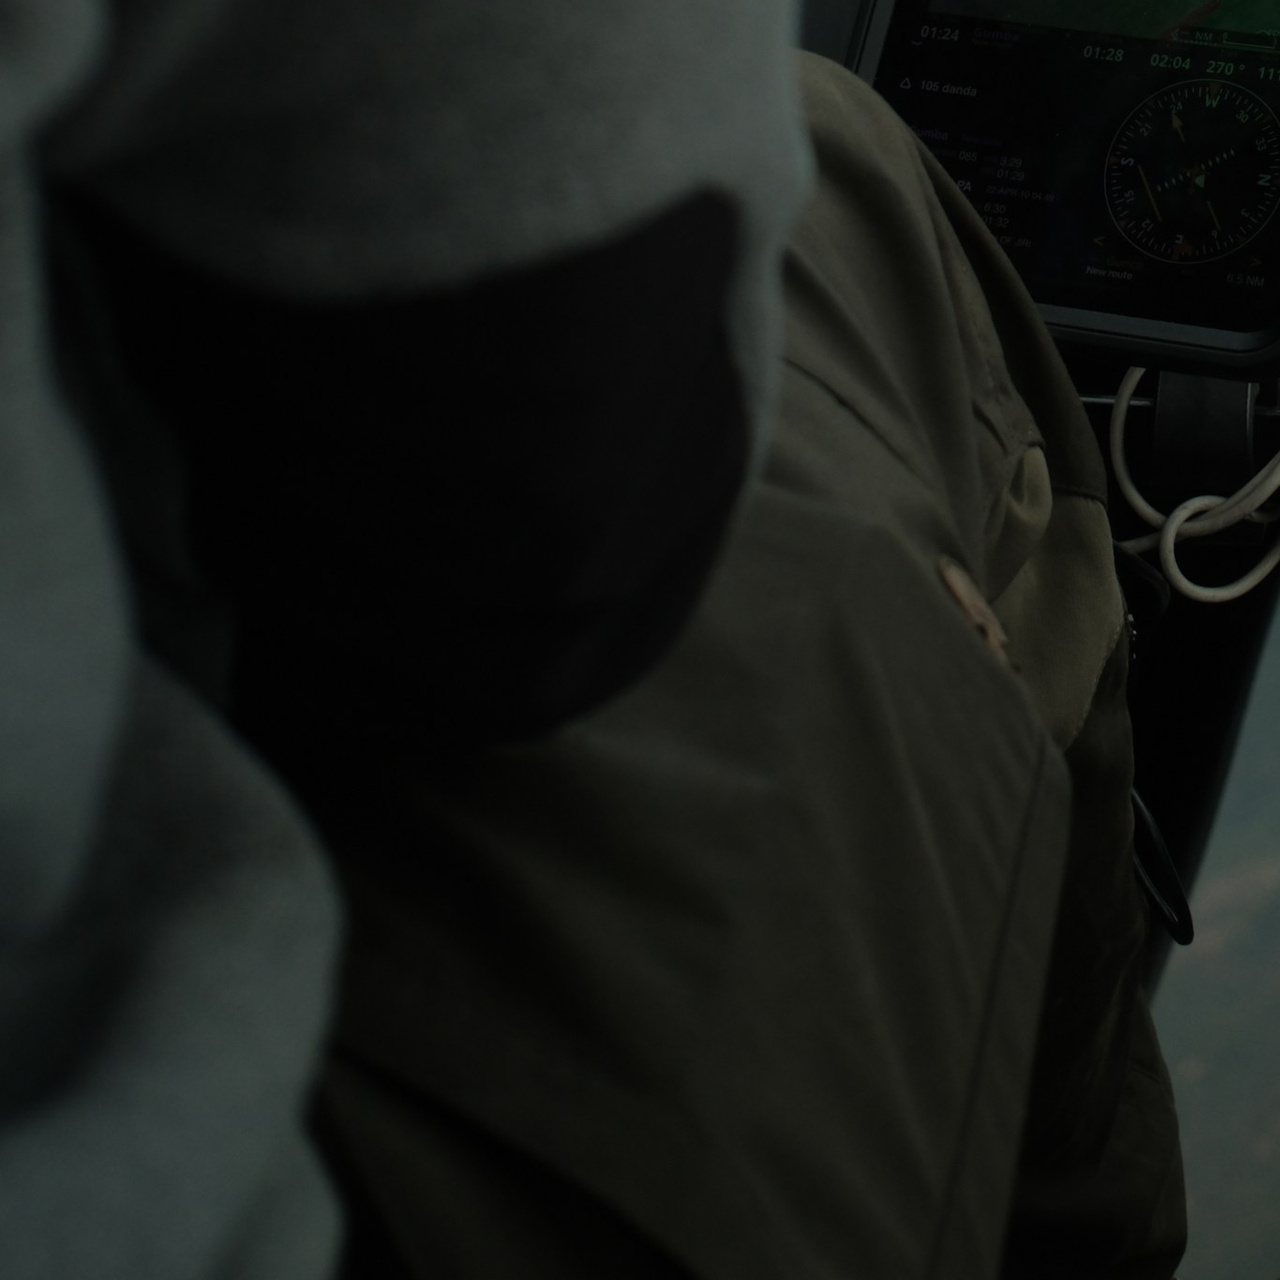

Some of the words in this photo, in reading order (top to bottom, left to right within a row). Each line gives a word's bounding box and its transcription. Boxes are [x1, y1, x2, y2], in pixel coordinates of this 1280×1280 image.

[921, 25, 960, 42] 01:24
[975, 27, 1020, 43] Gumba
[1195, 31, 1213, 42] NM
[1083, 44, 1125, 62] 01:28
[1150, 52, 1192, 71] 02:04
[1206, 60, 1235, 76] 270
[920, 80, 939, 93] 105
[942, 83, 978, 97] danda
[1170, 101, 1184, 114] 24
[1205, 95, 1221, 108] W
[1235, 110, 1250, 124] 30
[1139, 122, 1153, 137] 21
[1120, 156, 1135, 168] S
[1257, 173, 1272, 187] N
[1086, 265, 1108, 276] New
[1109, 268, 1134, 281] route
[1246, 273, 1265, 288] NM
